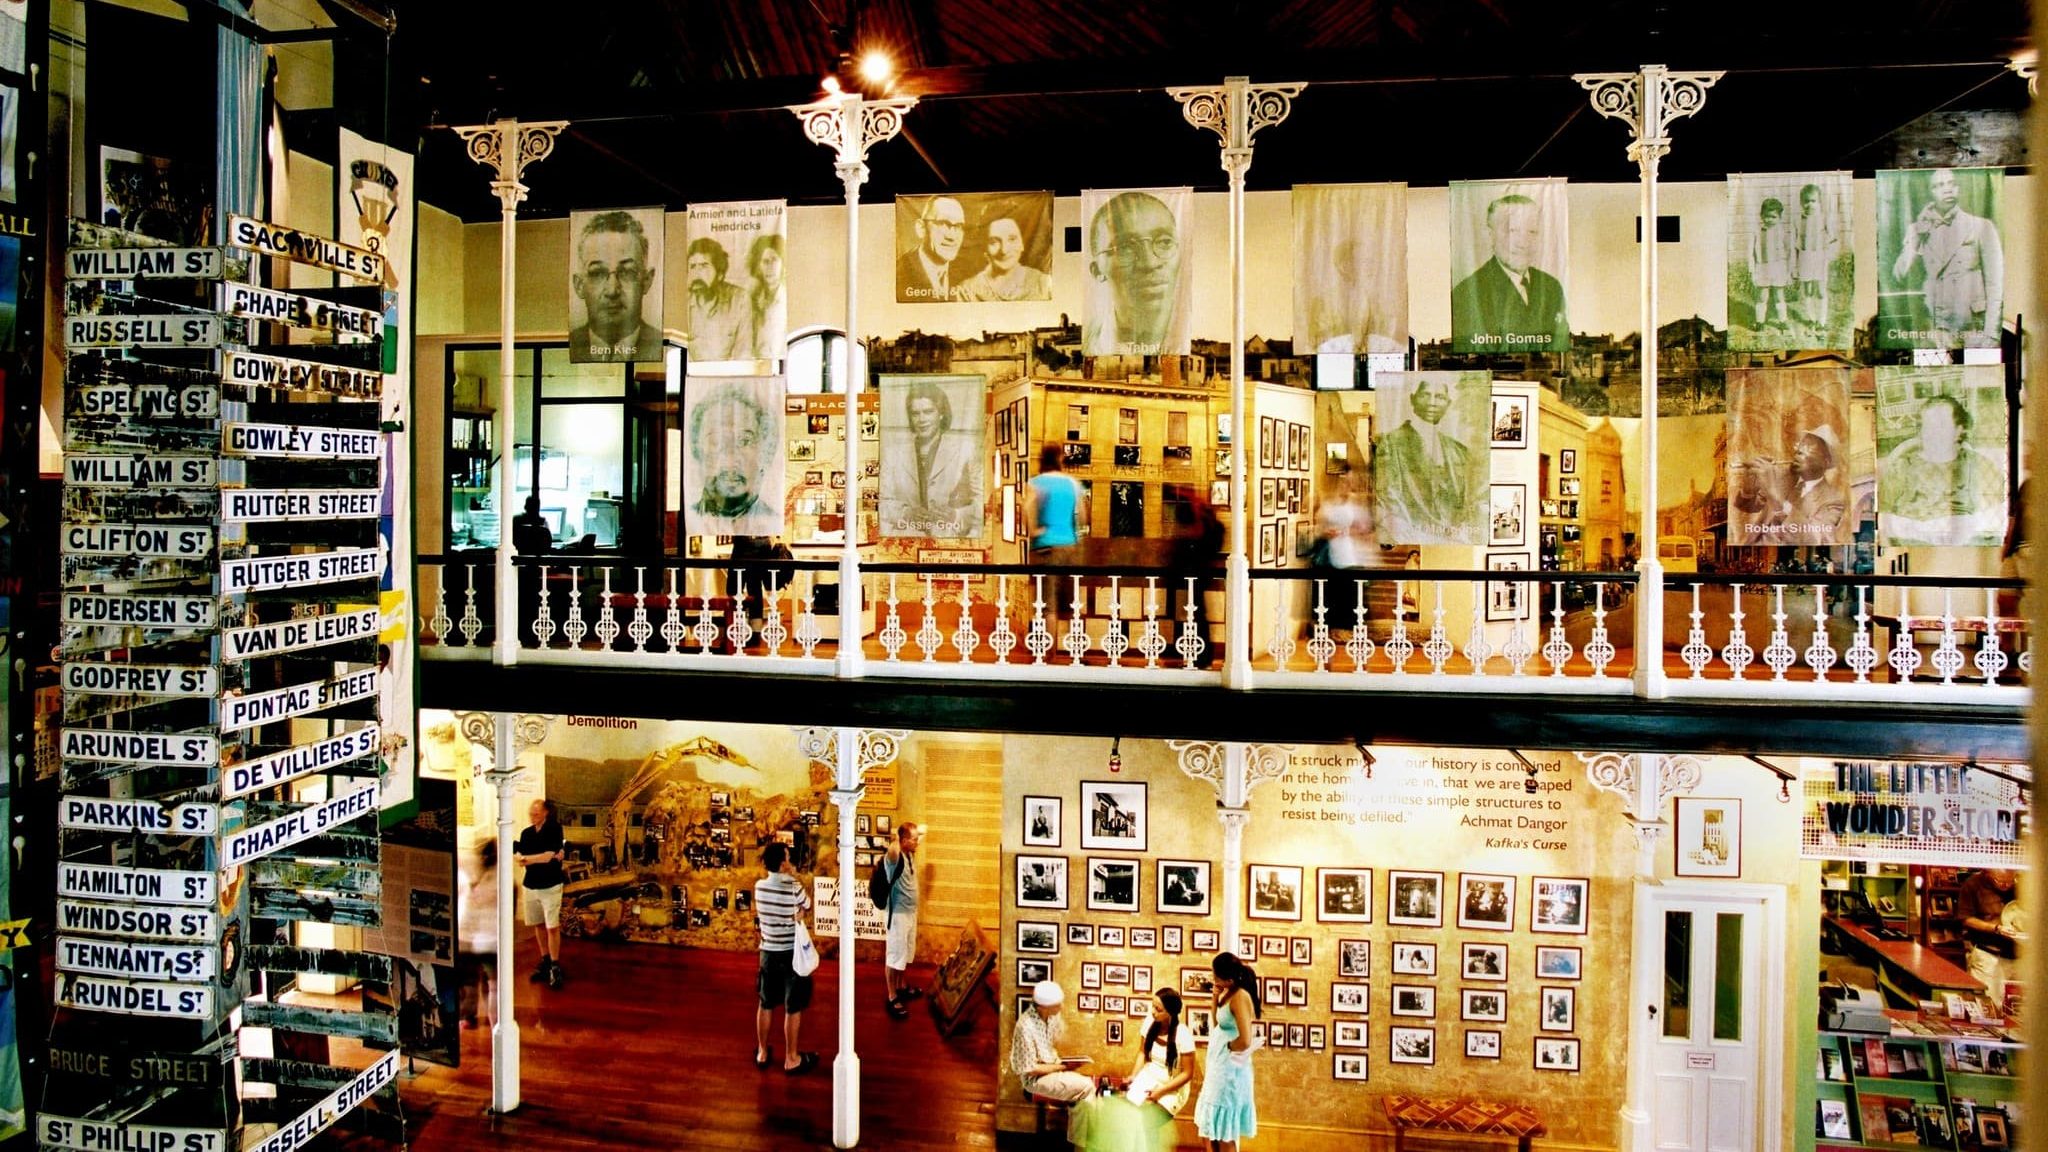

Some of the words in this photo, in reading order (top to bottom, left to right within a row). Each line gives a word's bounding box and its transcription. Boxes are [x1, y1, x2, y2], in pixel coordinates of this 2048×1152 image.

[726, 207, 746, 216] and
[711, 222, 761, 232] Hendricks
[72, 252, 175, 275] WILLIAM
[72, 320, 172, 343] RUSSELL
[1470, 333, 1502, 344] John
[1506, 333, 1552, 344] Gomas
[590, 345, 611, 354] Ben
[234, 358, 313, 389] COWLEY
[232, 428, 312, 451] COWLEY
[321, 433, 377, 454] STREET
[72, 460, 172, 483] WILLIAM
[233, 494, 310, 517] RUTGER
[319, 494, 377, 514] STREET
[897, 520, 931, 530] Cissie
[936, 520, 964, 530] Gool
[1744, 523, 1786, 533] Robert
[1789, 522, 1832, 533] Sithole
[69, 528, 170, 552] CLIFTON
[232, 561, 310, 588] RUTGER
[319, 553, 378, 579] STREET
[69, 598, 176, 623] PEDERSEN
[233, 627, 278, 654] VAN
[284, 621, 309, 644] DE
[315, 614, 358, 642] LEUR
[70, 666, 172, 692] GODFREY
[234, 688, 311, 724] PONTAC
[319, 672, 376, 708] STREET
[568, 715, 638, 730] Demolition
[66, 734, 176, 761] ARUNDEL
[234, 770, 264, 792] DE
[270, 736, 354, 780] VILLIERS
[1289, 754, 1298, 766] It
[1302, 754, 1342, 766] struck
[1432, 758, 1478, 773] history
[1482, 759, 1491, 771] is
[1496, 760, 1561, 772] contined
[1282, 773, 1293, 784] in
[1298, 772, 1318, 784] the
[1443, 776, 1469, 789] that
[1474, 780, 1495, 789] we
[1499, 780, 1520, 790] are
[1834, 762, 1876, 794] THE
[1890, 763, 1971, 796] LITTLE
[317, 788, 374, 830] STREET
[1282, 790, 1297, 804] by
[1301, 790, 1322, 802] the
[1426, 794, 1470, 808] simple
[1476, 797, 1544, 809] structures
[1548, 800, 1562, 810] to
[69, 801, 172, 830] PARKINS
[1282, 810, 1316, 820] resist
[1320, 809, 1356, 824] being
[1460, 814, 1512, 828] Achmat
[1518, 816, 1568, 833] Dangor
[1826, 802, 1938, 837] WONDER
[1486, 838, 1528, 850] Kafka's
[1532, 838, 1568, 850] Curse
[66, 868, 162, 898] HAMILTON
[64, 904, 172, 934] WINDSOR
[66, 943, 165, 972] TENNANT
[62, 978, 171, 1012] ARUNDEL
[50, 1048, 110, 1078] BRUCE
[130, 1058, 210, 1083] STREET
[338, 1056, 394, 1114] STREET
[82, 1125, 176, 1152] PHILLIP
